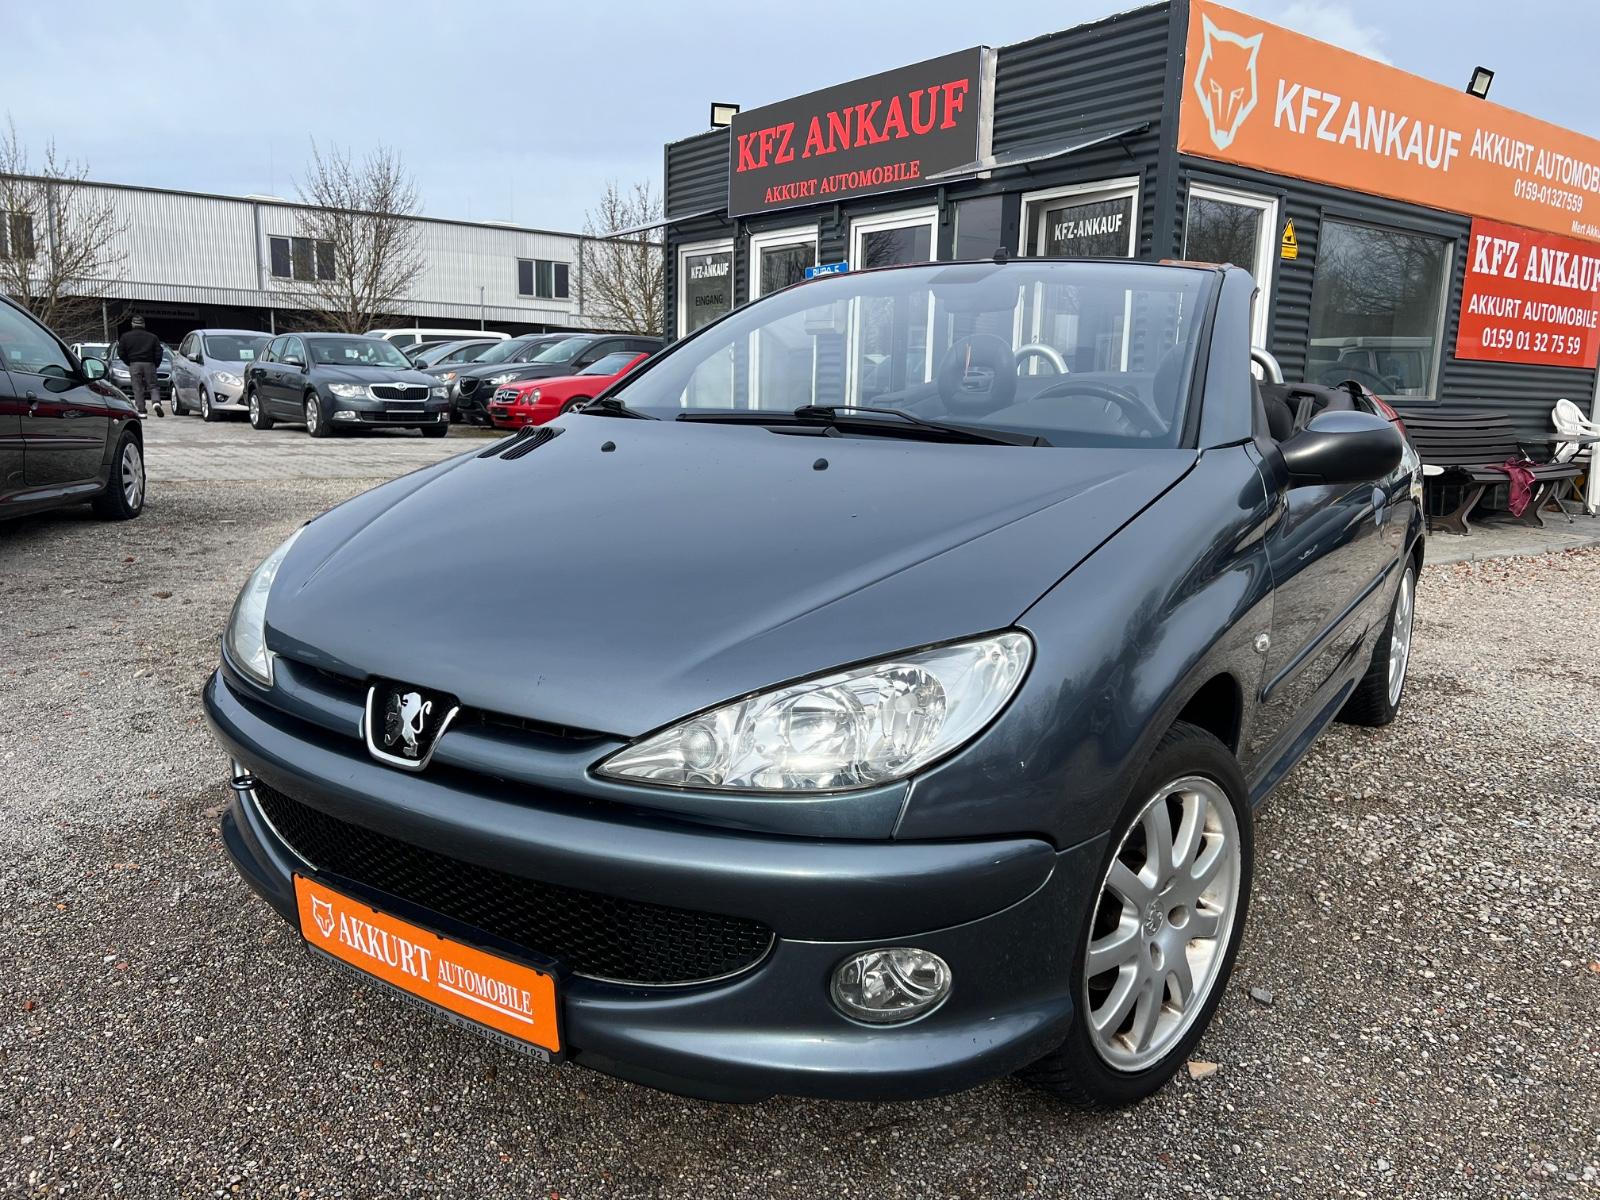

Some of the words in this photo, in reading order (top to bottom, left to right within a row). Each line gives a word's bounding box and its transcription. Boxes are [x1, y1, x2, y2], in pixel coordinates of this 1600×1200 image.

[736, 122, 795, 172] KFZ
[802, 79, 969, 158] ANKAUF
[1470, 128, 1534, 173] AKKURT
[764, 179, 818, 203] AKKURT
[820, 160, 920, 195] AUTOMOBILE
[1514, 178, 1583, 213] 0159-01327559
[1054, 213, 1123, 241] KFZ-ANKAUF
[690, 263, 729, 279] KFZ-ANKAUF
[1472, 235, 1520, 278] KFZ
[695, 294, 724, 307] EINGANG
[1467, 293, 1522, 318] AKKURT
[1522, 301, 1598, 328] AUTOMOBILE
[1482, 327, 1513, 349] 0159
[1516, 331, 1530, 350] 01
[1534, 333, 1549, 352] 32
[1551, 335, 1565, 354] 75
[1567, 337, 1581, 355] 59
[339, 912, 432, 982] AKKURT
[438, 958, 533, 1015] AUTOMOBILE
[530, 1048, 543, 1060] 02
